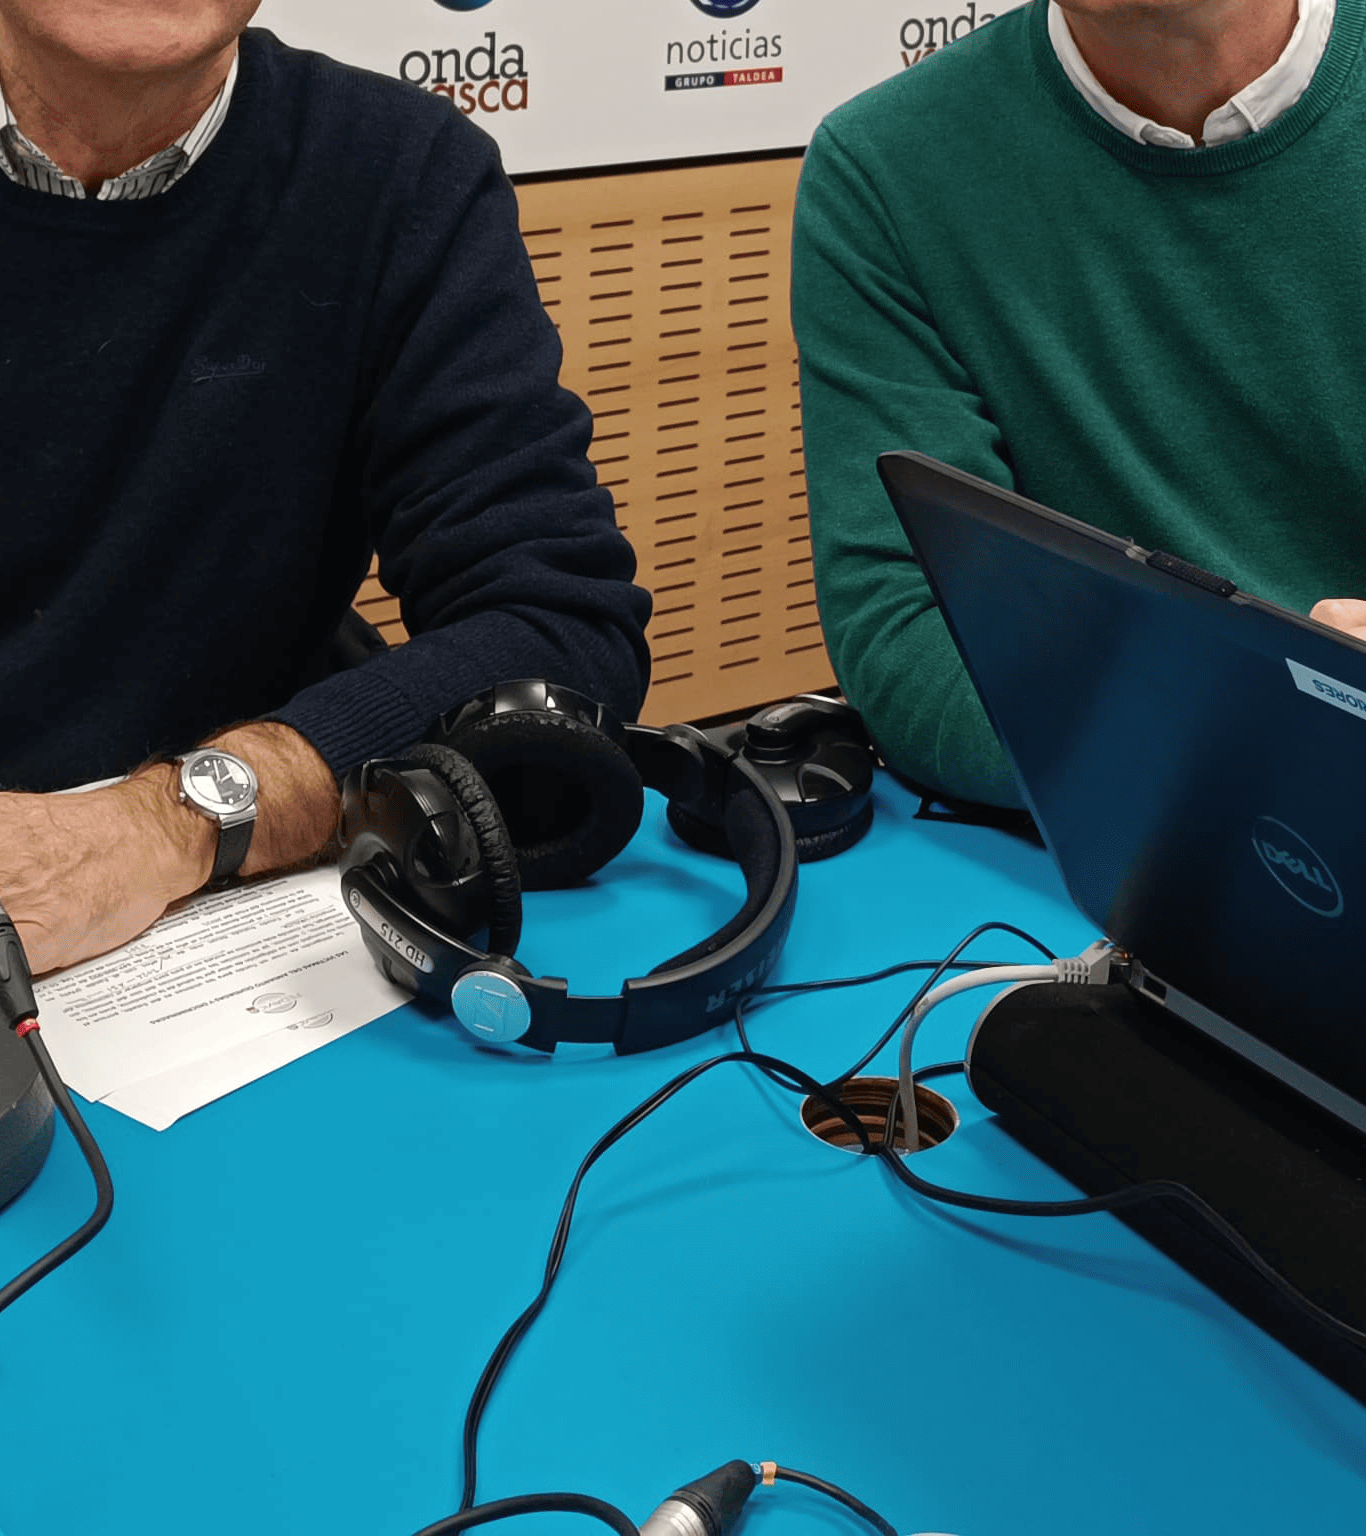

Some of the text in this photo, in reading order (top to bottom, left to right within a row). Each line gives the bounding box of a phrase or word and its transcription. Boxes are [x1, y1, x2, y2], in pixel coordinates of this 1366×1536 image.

[666, 29, 783, 65] noticias
[899, 2, 996, 49] ond
[399, 31, 528, 85] onda
[674, 69, 776, 88] GRUPO TALDEA
[378, 922, 426, 968] HD 215
